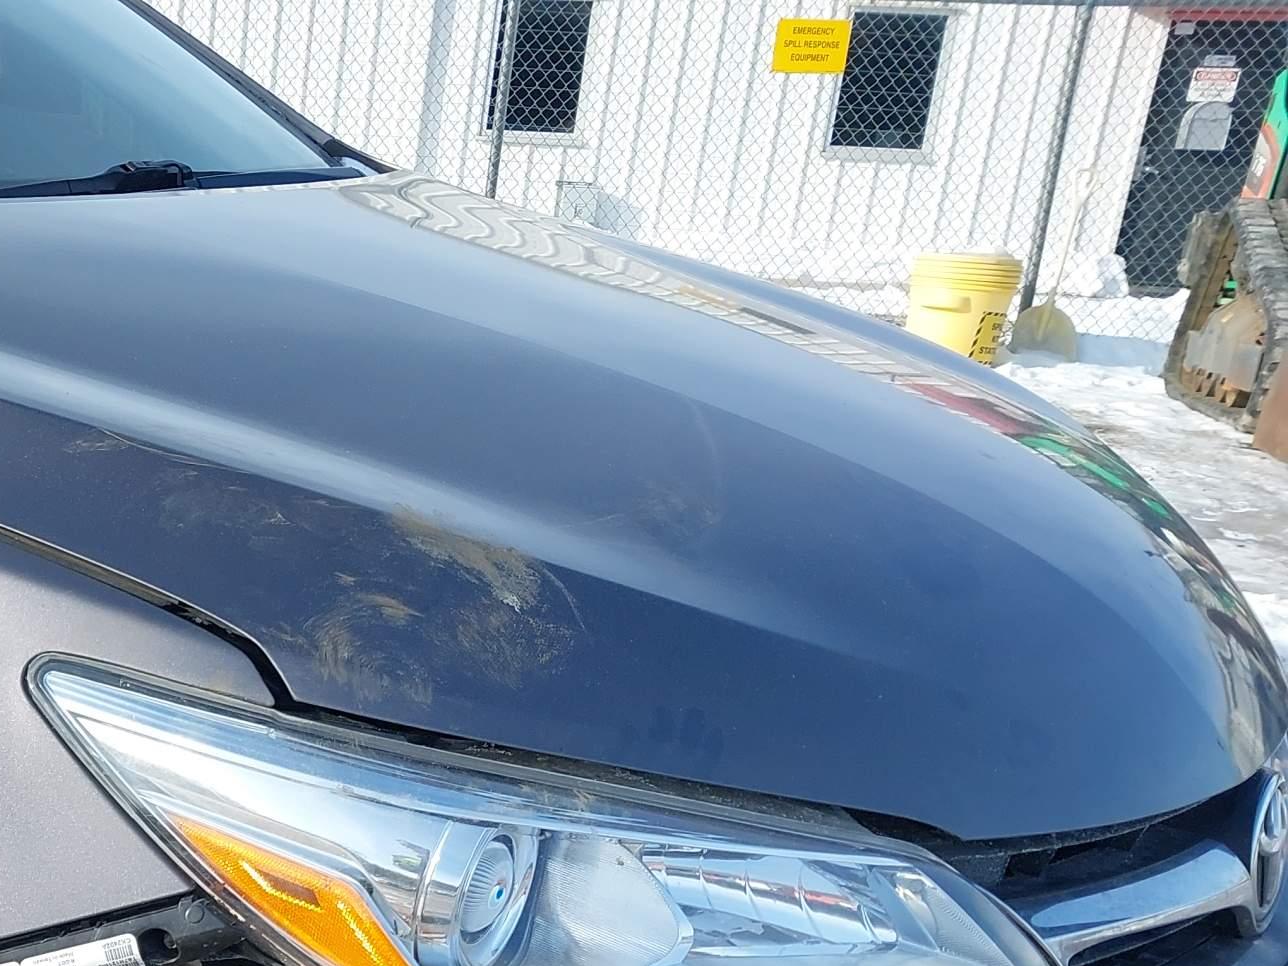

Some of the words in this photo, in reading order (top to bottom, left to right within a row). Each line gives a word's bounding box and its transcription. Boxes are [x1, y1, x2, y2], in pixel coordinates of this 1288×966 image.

[793, 26, 835, 35] EMERGENCY
[784, 40, 801, 48] SPILL
[803, 40, 840, 49] RESPONSE
[791, 53, 830, 62] EQUIPMENT
